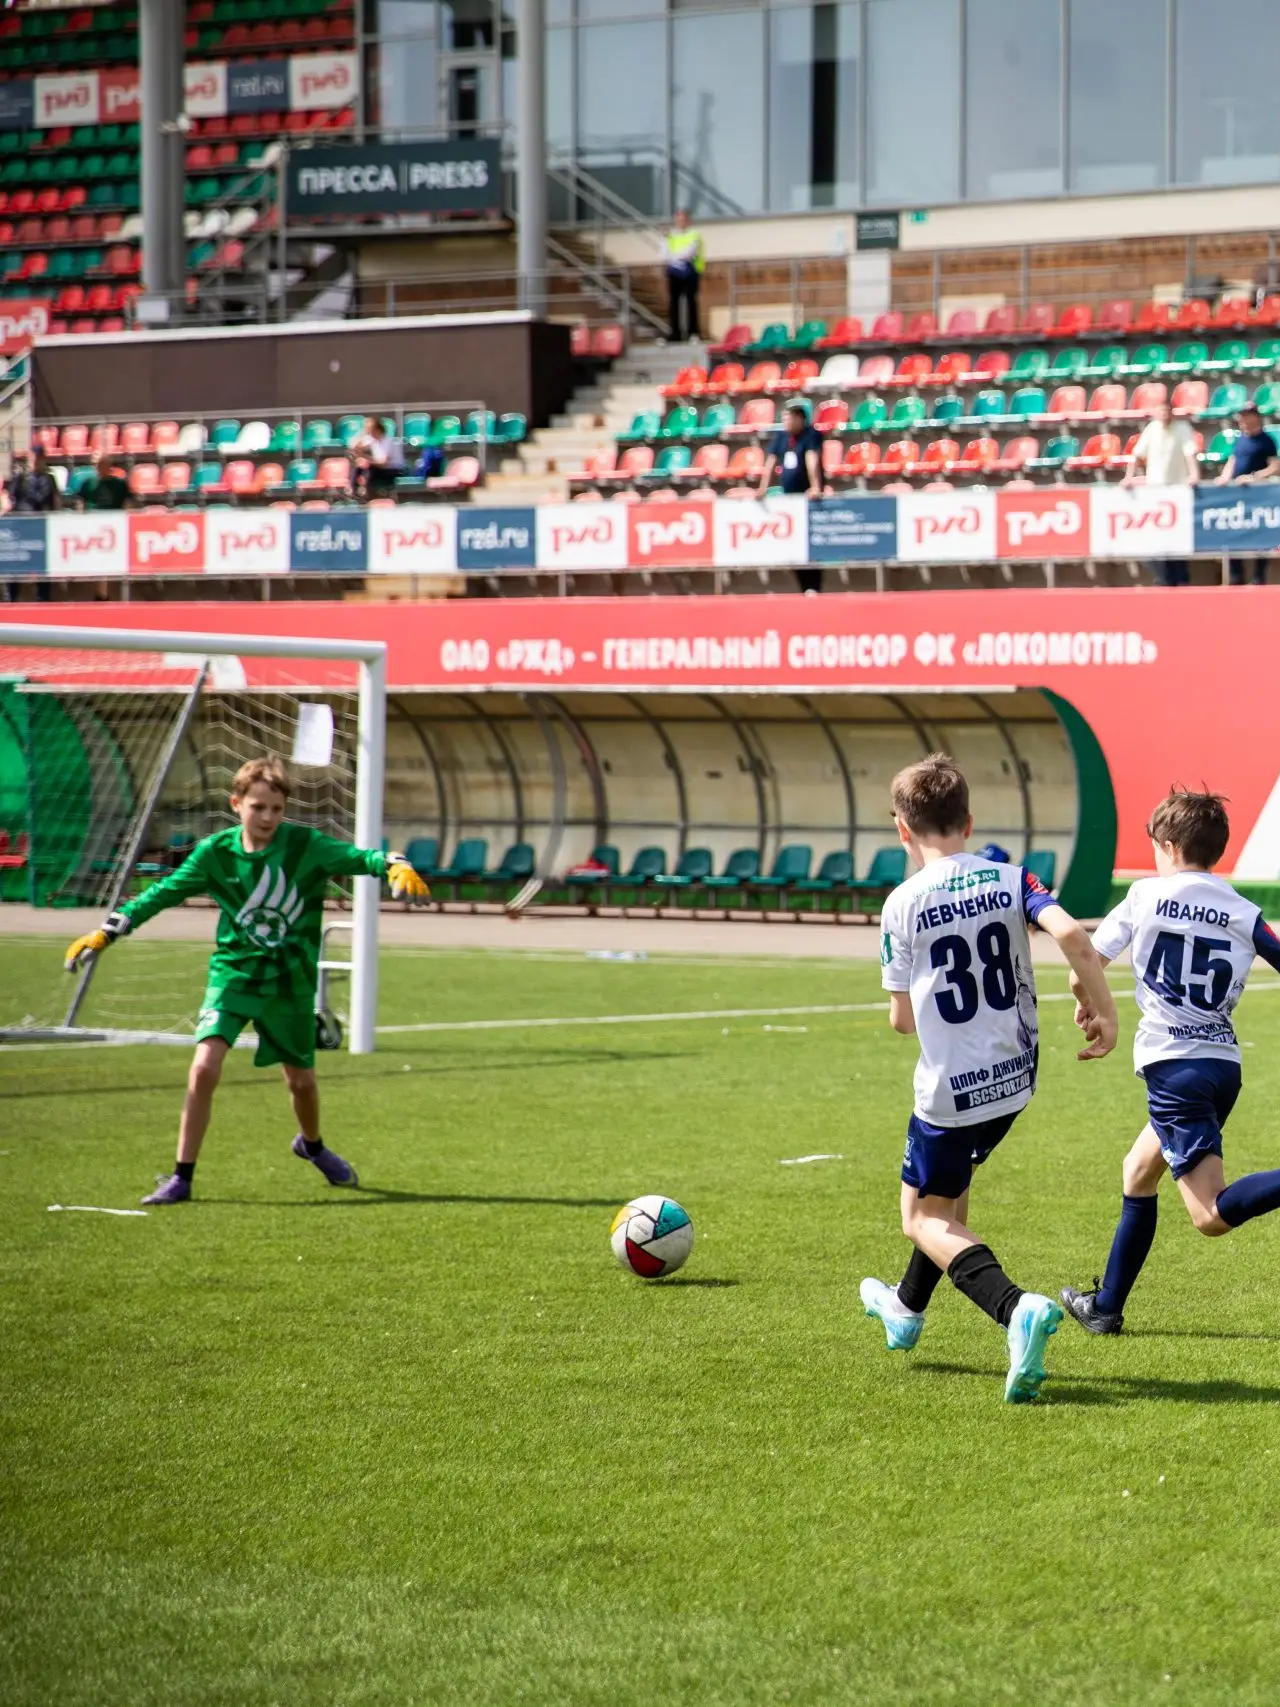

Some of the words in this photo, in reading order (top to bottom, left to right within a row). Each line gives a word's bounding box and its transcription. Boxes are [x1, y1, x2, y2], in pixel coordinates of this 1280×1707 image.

[298, 165, 398, 195] ПРЕССА
[409, 160, 489, 190] PRESS
[295, 525, 362, 552] rzd.ru
[460, 521, 530, 550] rzd.ru
[440, 638, 490, 672] ОАО
[496, 638, 575, 675] «РЖД»
[602, 629, 782, 670] ГЕНЕРАЛЬНЫЙ
[788, 633, 908, 669] СПОНСОР
[914, 632, 956, 667] ФК
[962, 632, 1158, 667] «ЛОКОМОТИВ»
[916, 891, 1012, 933] ЛЕВЧЕНКО
[1156, 899, 1230, 928] ИВАНОВ
[930, 922, 1017, 1024] 38
[1143, 931, 1233, 1011] 45
[950, 1068, 989, 1091] ЦППФ
[969, 1072, 1031, 1107] JSCSPORT.RU
